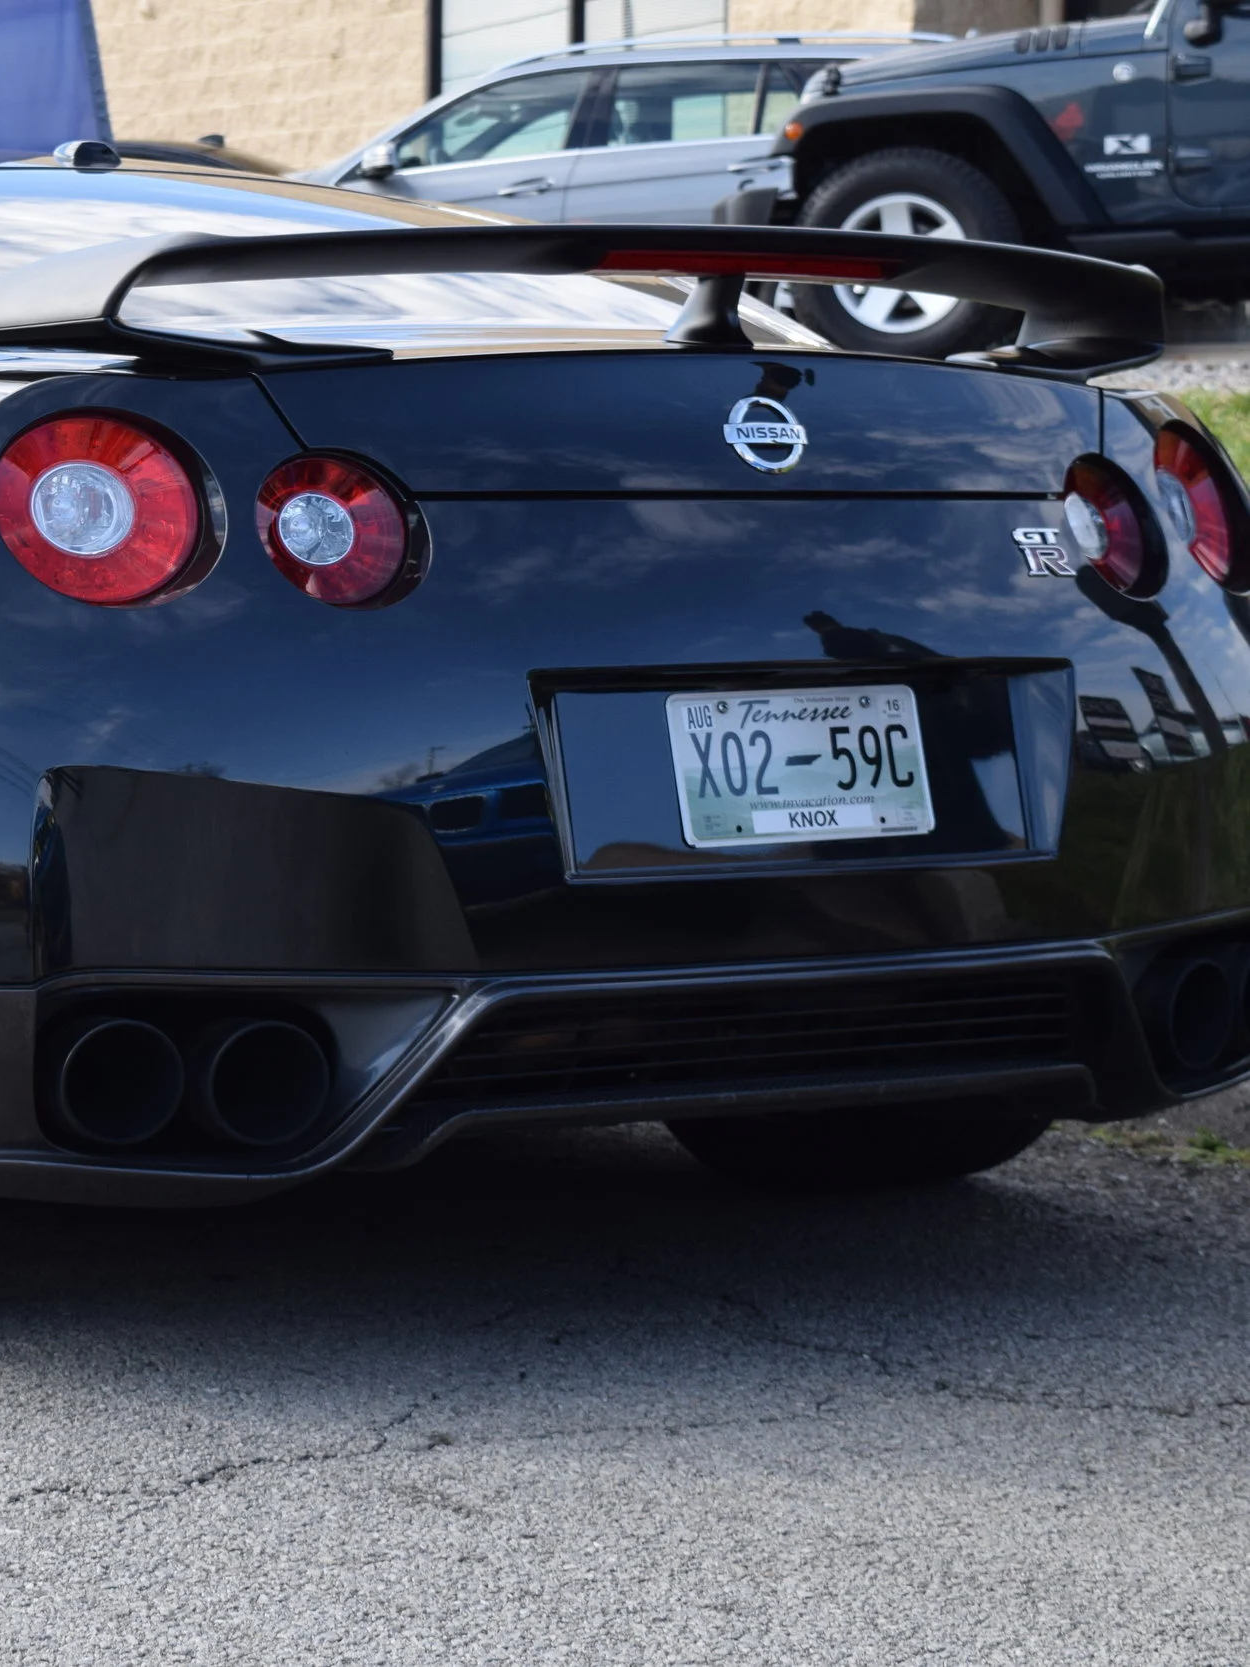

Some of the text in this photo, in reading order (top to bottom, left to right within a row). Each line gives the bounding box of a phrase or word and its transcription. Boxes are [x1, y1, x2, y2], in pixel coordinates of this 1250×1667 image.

[736, 427, 801, 440] NISSAN
[1012, 527, 1060, 544] GT
[1018, 544, 1077, 576] R
[738, 699, 852, 730] Tennessee
[886, 699, 900, 711] 16
[687, 705, 713, 730] AUG
[787, 810, 839, 829] KNOX
